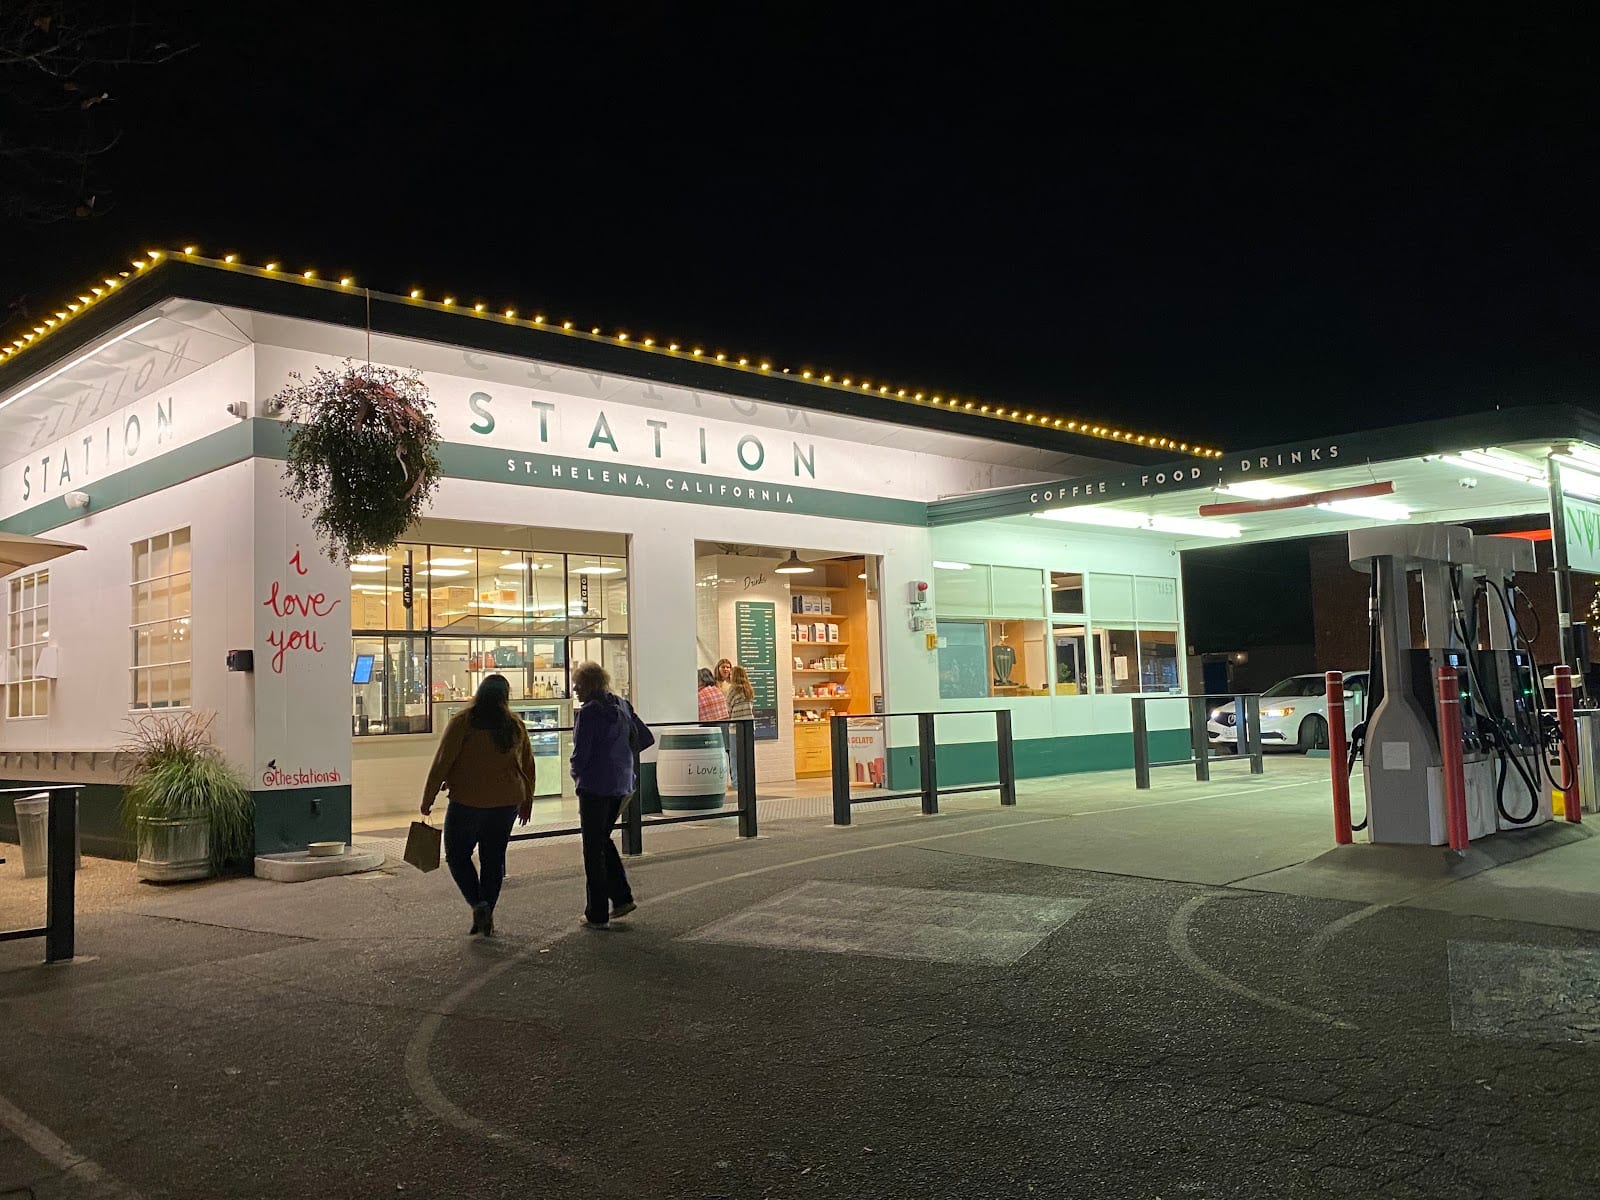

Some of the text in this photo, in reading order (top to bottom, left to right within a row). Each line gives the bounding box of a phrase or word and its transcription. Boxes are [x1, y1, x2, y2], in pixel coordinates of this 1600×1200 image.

[23, 397, 173, 501] STATION
[469, 391, 816, 479] STATION
[507, 459, 794, 504] ST. HELENA, CALIFORNIA
[1030, 445, 1341, 504] COFFEE FOOD DRINKS
[263, 581, 341, 617] love
[403, 591, 411, 603] UP
